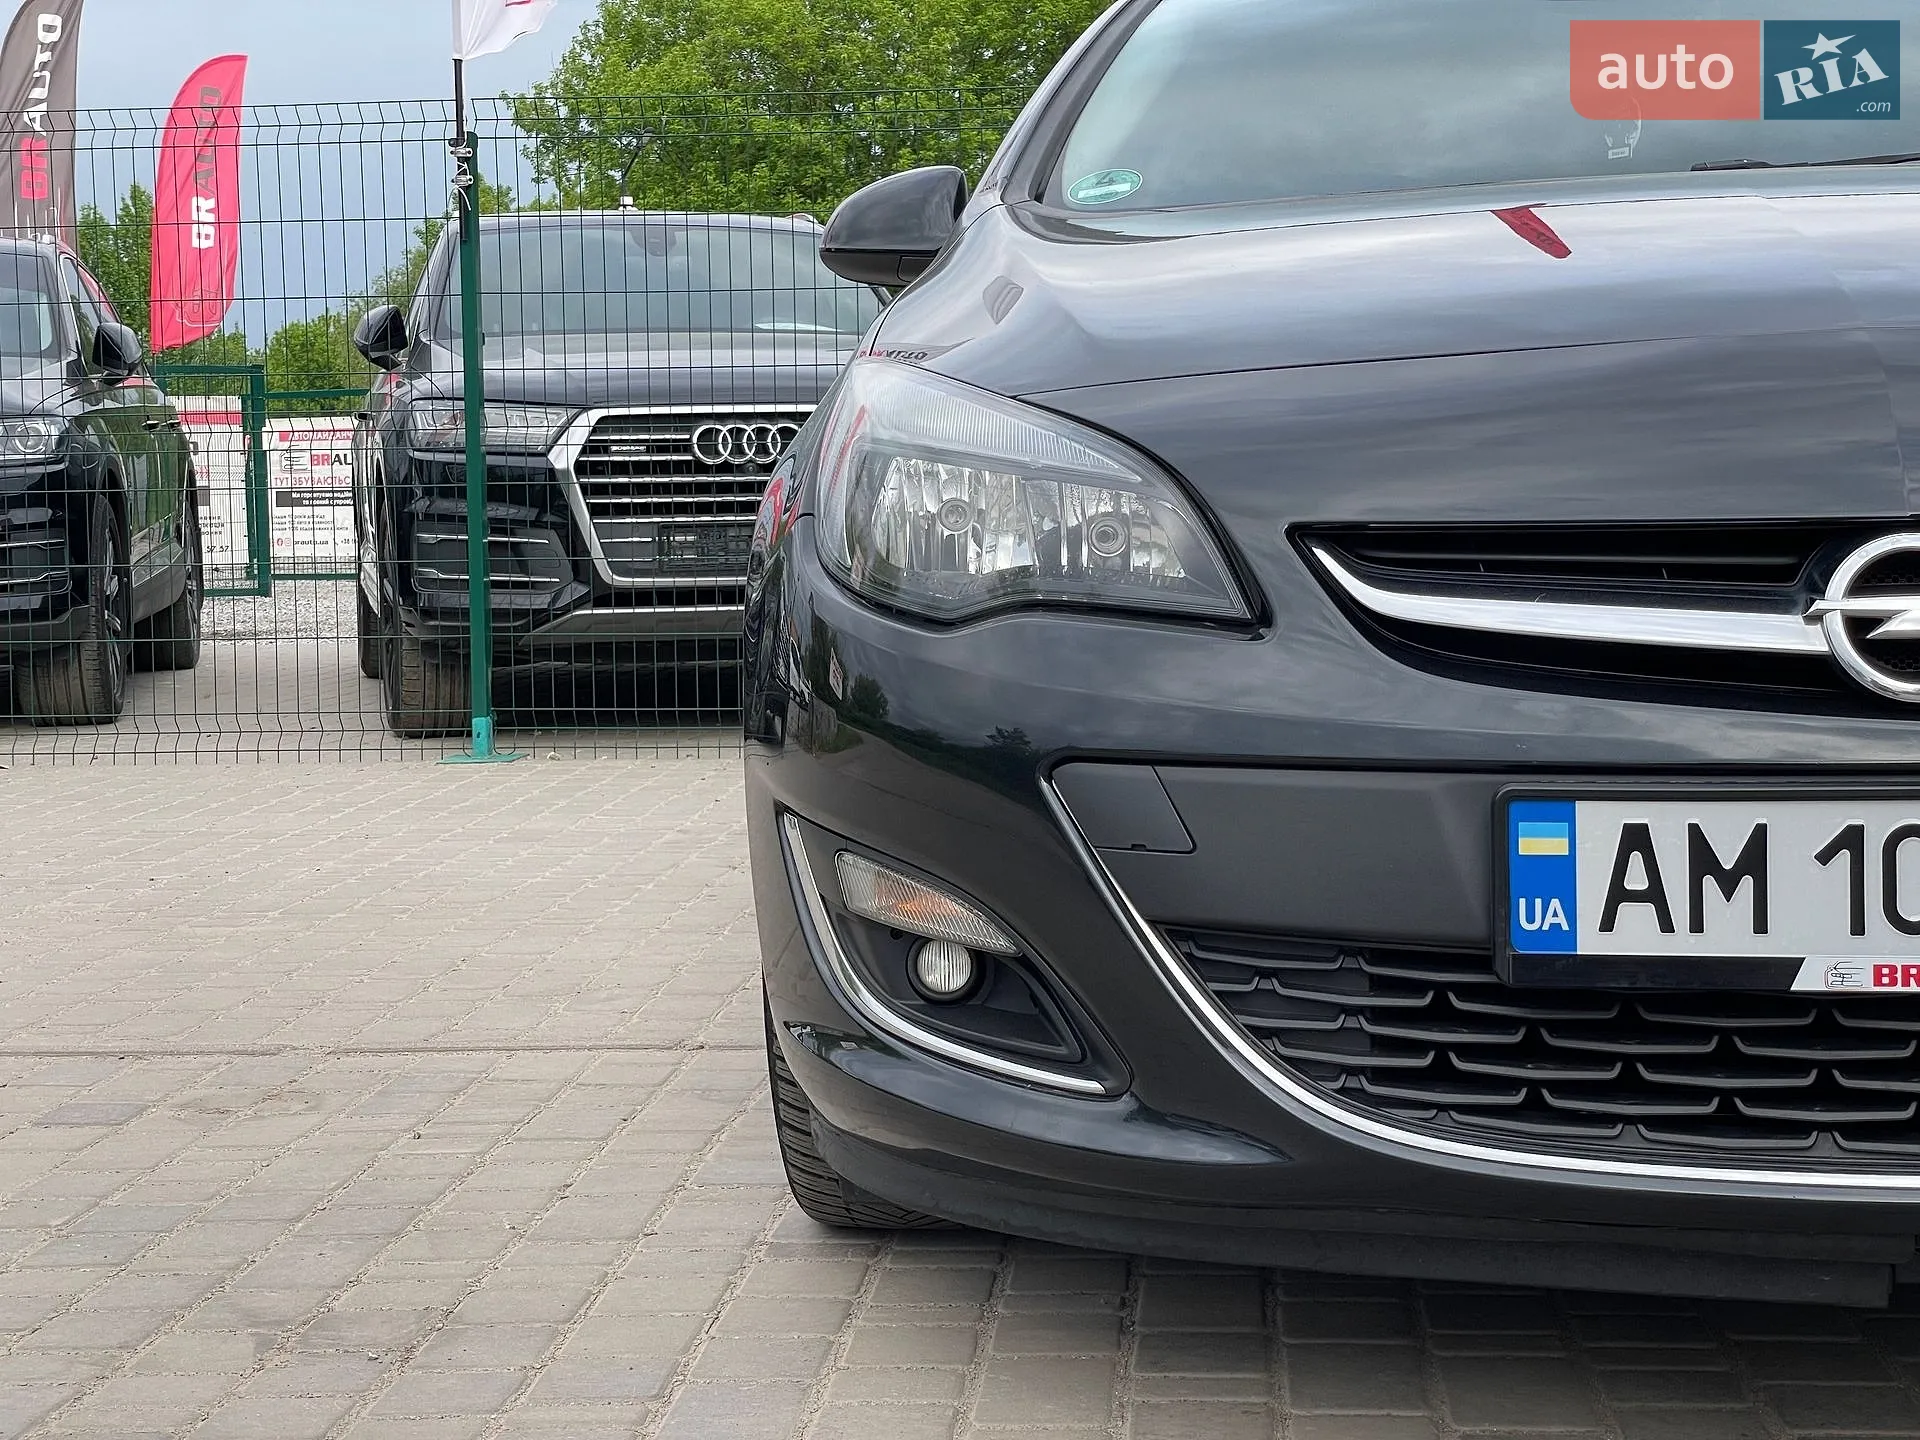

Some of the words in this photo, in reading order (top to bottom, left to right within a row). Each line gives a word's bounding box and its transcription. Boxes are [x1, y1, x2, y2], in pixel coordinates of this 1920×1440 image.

[20, 13, 63, 201] BRAUTO
[191, 86, 223, 250] BRAUTO
[274, 477, 289, 486] ТУТ
[1518, 898, 1570, 932] UA
[1597, 822, 1769, 935] AM
[1812, 822, 1920, 937] 10
[1872, 963, 1920, 988] BR
